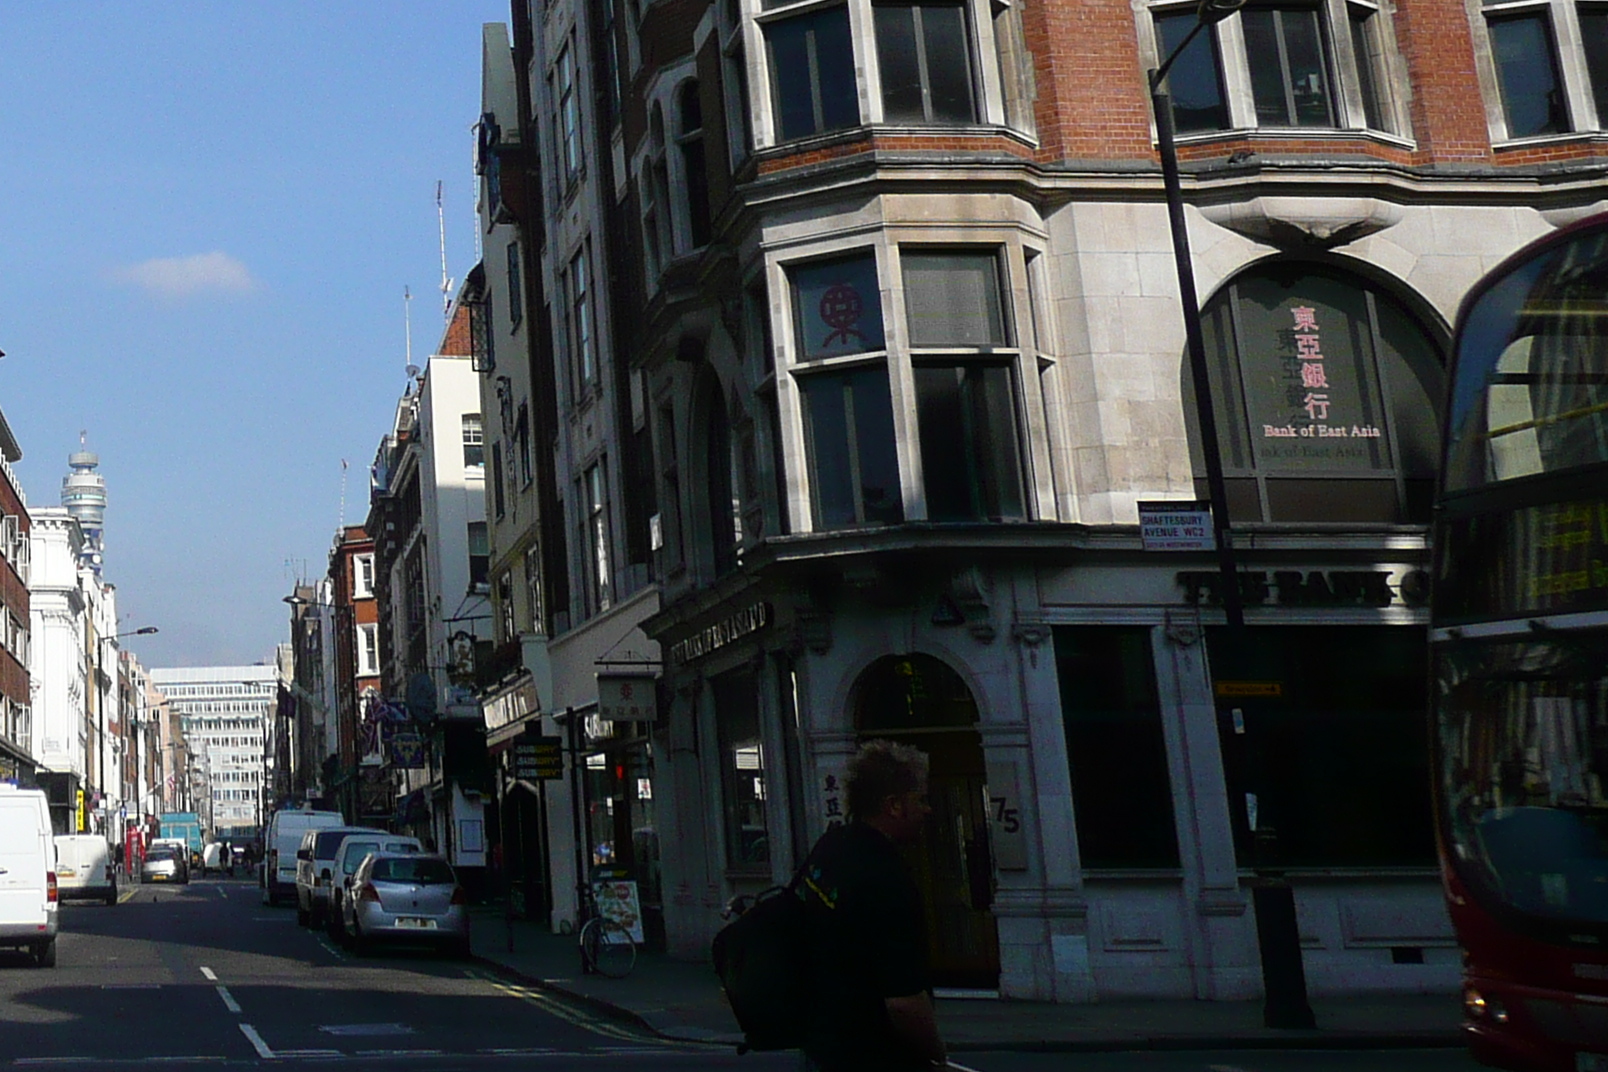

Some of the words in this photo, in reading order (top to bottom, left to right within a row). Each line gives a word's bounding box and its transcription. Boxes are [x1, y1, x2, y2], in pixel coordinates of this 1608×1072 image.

[1290, 305, 1331, 420] 東亞銀行
[1263, 424, 1298, 438] Bank
[1300, 424, 1316, 438] of
[1317, 424, 1348, 438] East
[1351, 424, 1381, 438] Asia
[1141, 515, 1203, 526] SHAFTESBURY
[1143, 527, 1180, 537] AVENUE
[1183, 527, 1205, 537] WC2
[1274, 570, 1397, 608] BANK
[1400, 569, 1433, 607] O
[991, 797, 1020, 833] 75
